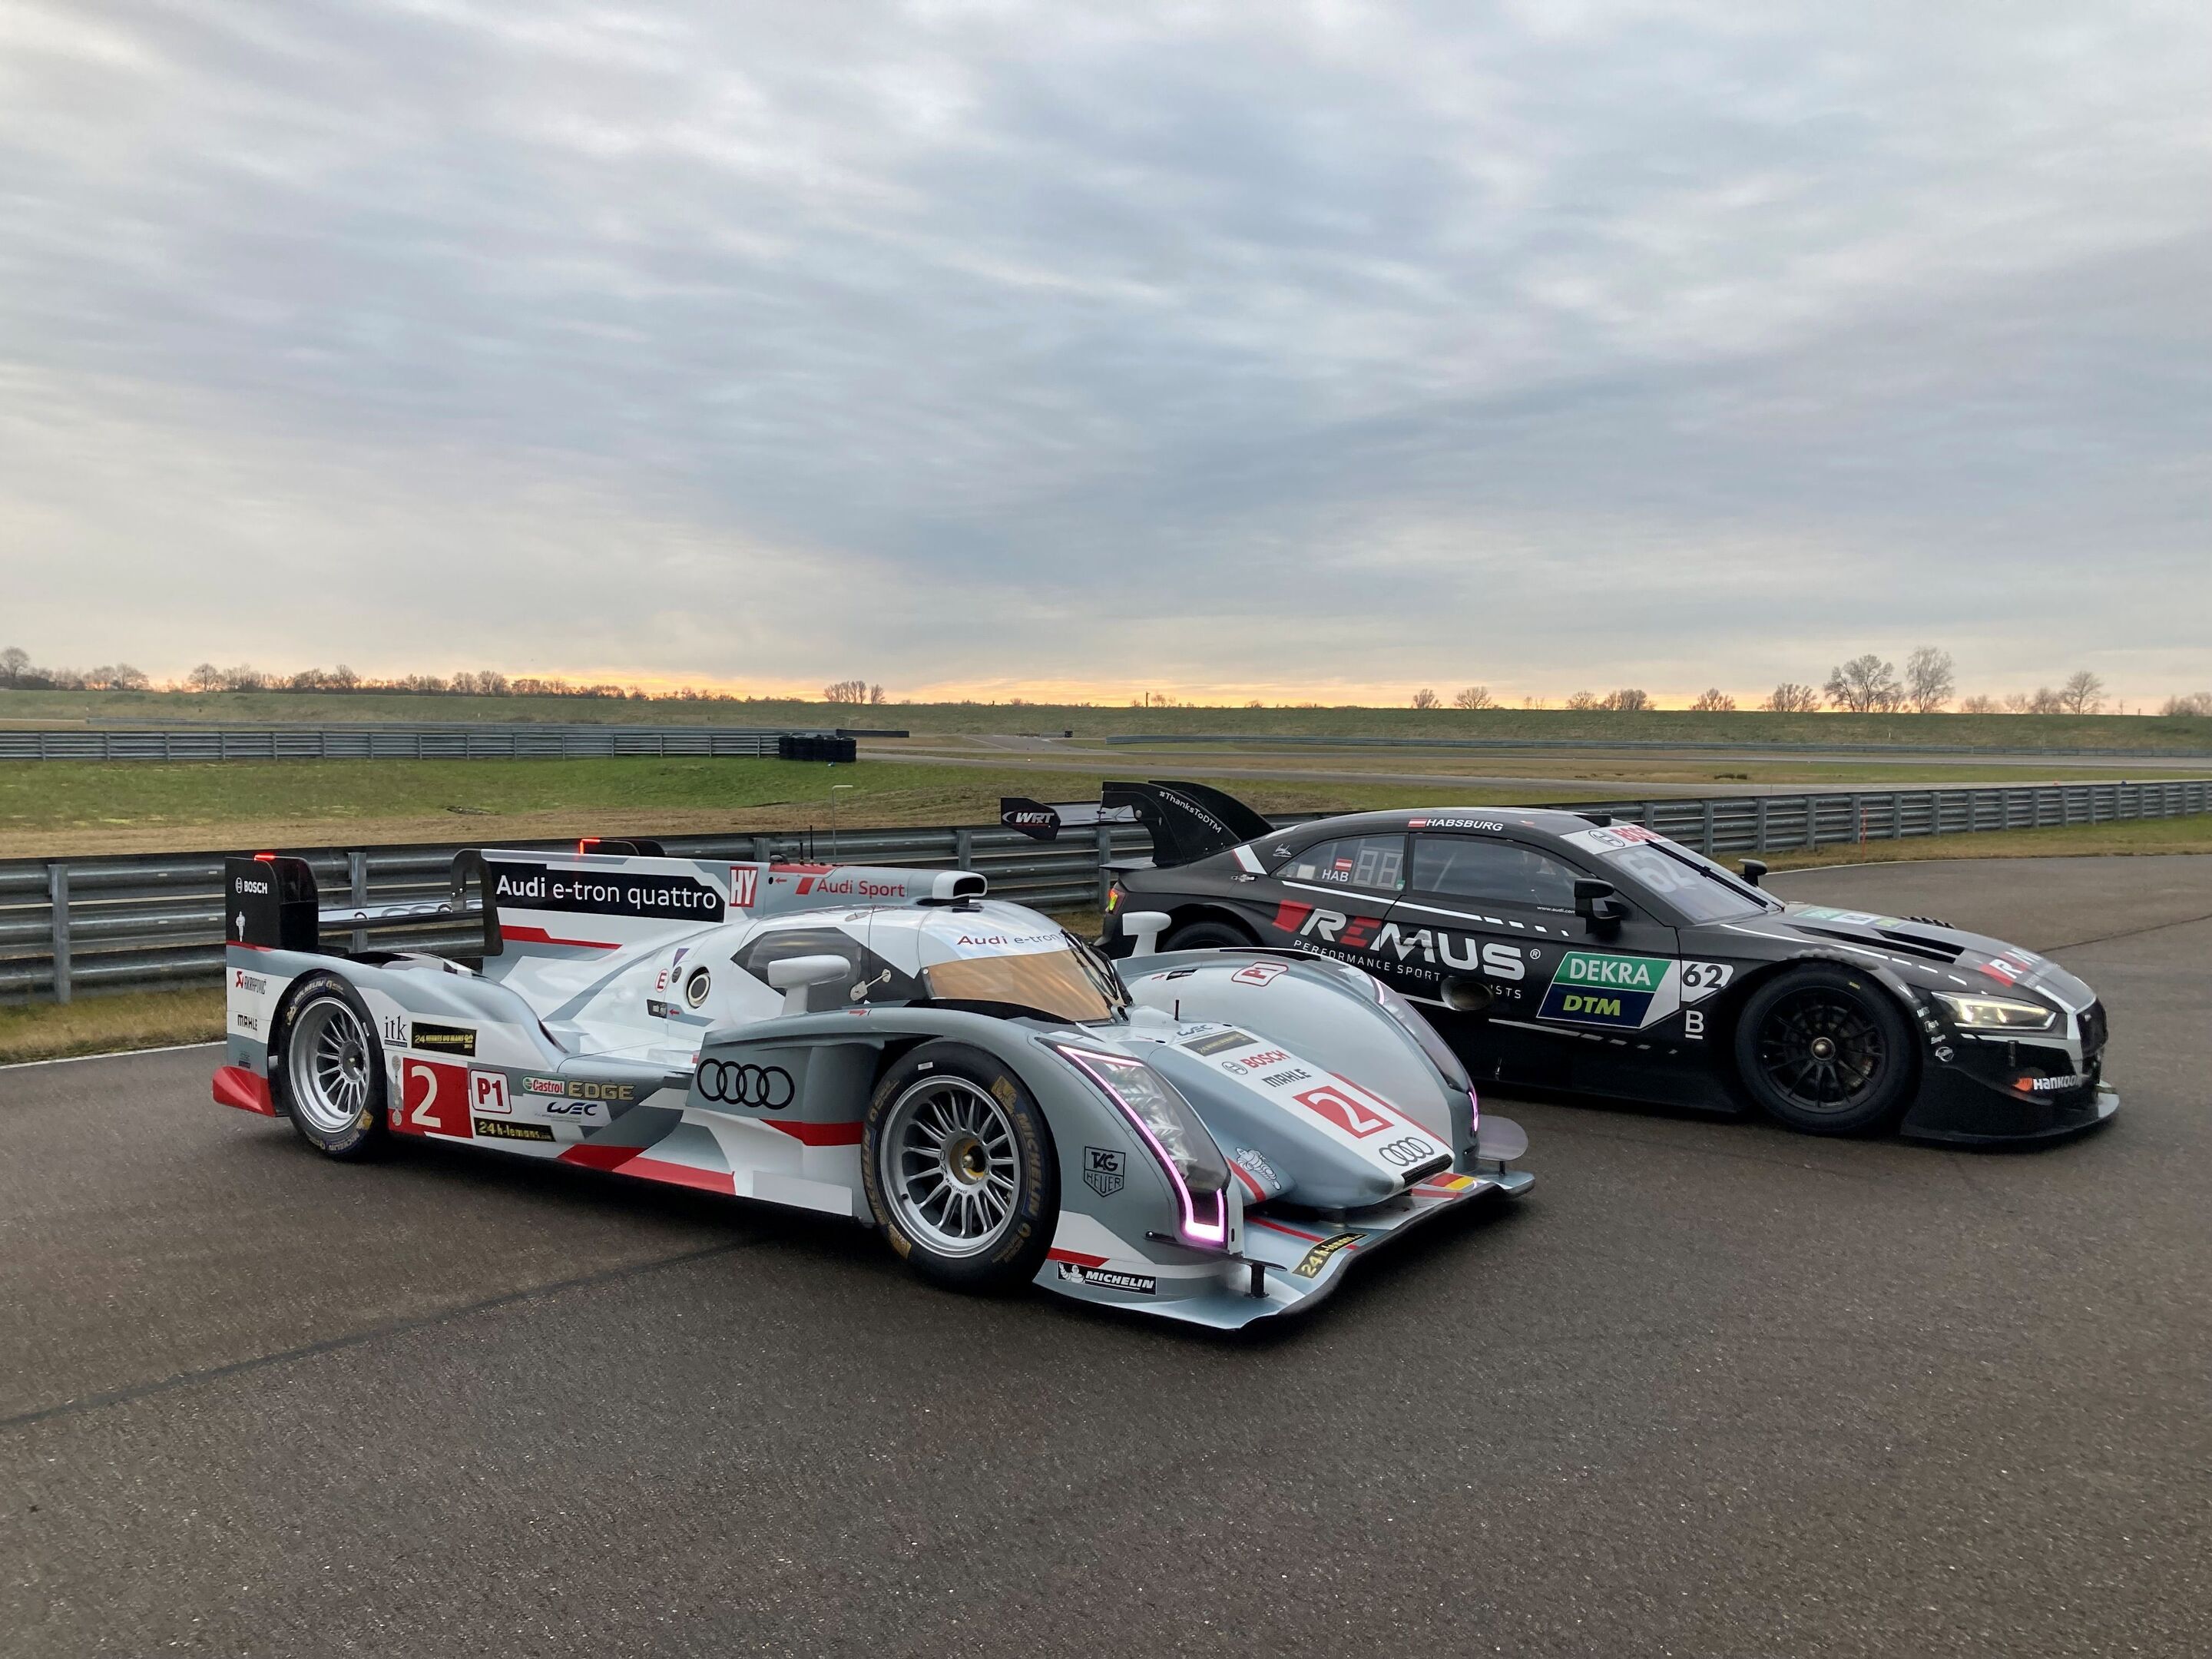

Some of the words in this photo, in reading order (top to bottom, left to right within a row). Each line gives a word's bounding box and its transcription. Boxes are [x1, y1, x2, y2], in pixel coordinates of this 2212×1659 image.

[1015, 812, 1055, 823] WRT
[1159, 790, 1222, 833] #ThanksToDTM
[1426, 818, 1503, 831] HABSBURG
[1609, 826, 1662, 843] BOSC
[1322, 869, 1349, 882] HAB
[243, 880, 268, 895] BOSCH
[496, 875, 546, 898] Audi
[552, 881, 620, 902] e-tron
[627, 886, 717, 909] quattro
[730, 869, 757, 905] HY
[816, 877, 854, 895] Audi
[858, 880, 906, 899] Sport
[956, 935, 1008, 945] Audi
[1014, 932, 1058, 944] e-tron
[1300, 908, 1525, 981] REMUS
[1293, 939, 1390, 971] PERFORMANCE
[1397, 965, 1441, 982] SPORT
[1570, 958, 1652, 987] DEKRA
[1682, 962, 1724, 989] 62
[1563, 995, 1621, 1017] DTM
[237, 1014, 258, 1031] MAHLE
[384, 1015, 408, 1041] itk
[1240, 1050, 1291, 1068] BOSCH
[1261, 1068, 1312, 1088] MAHLE
[2032, 1075, 2082, 1090] Hankoo
[411, 1065, 442, 1128] 2
[477, 1077, 504, 1107] P1
[532, 1079, 564, 1094] Castrol
[568, 1081, 635, 1101] EDGE
[547, 1101, 598, 1116] WEC
[1307, 1092, 1384, 1132] 2
[1091, 1151, 1118, 1172] TAG
[1086, 1172, 1121, 1194] HEUER
[1085, 1270, 1154, 1289] MICHELIN
